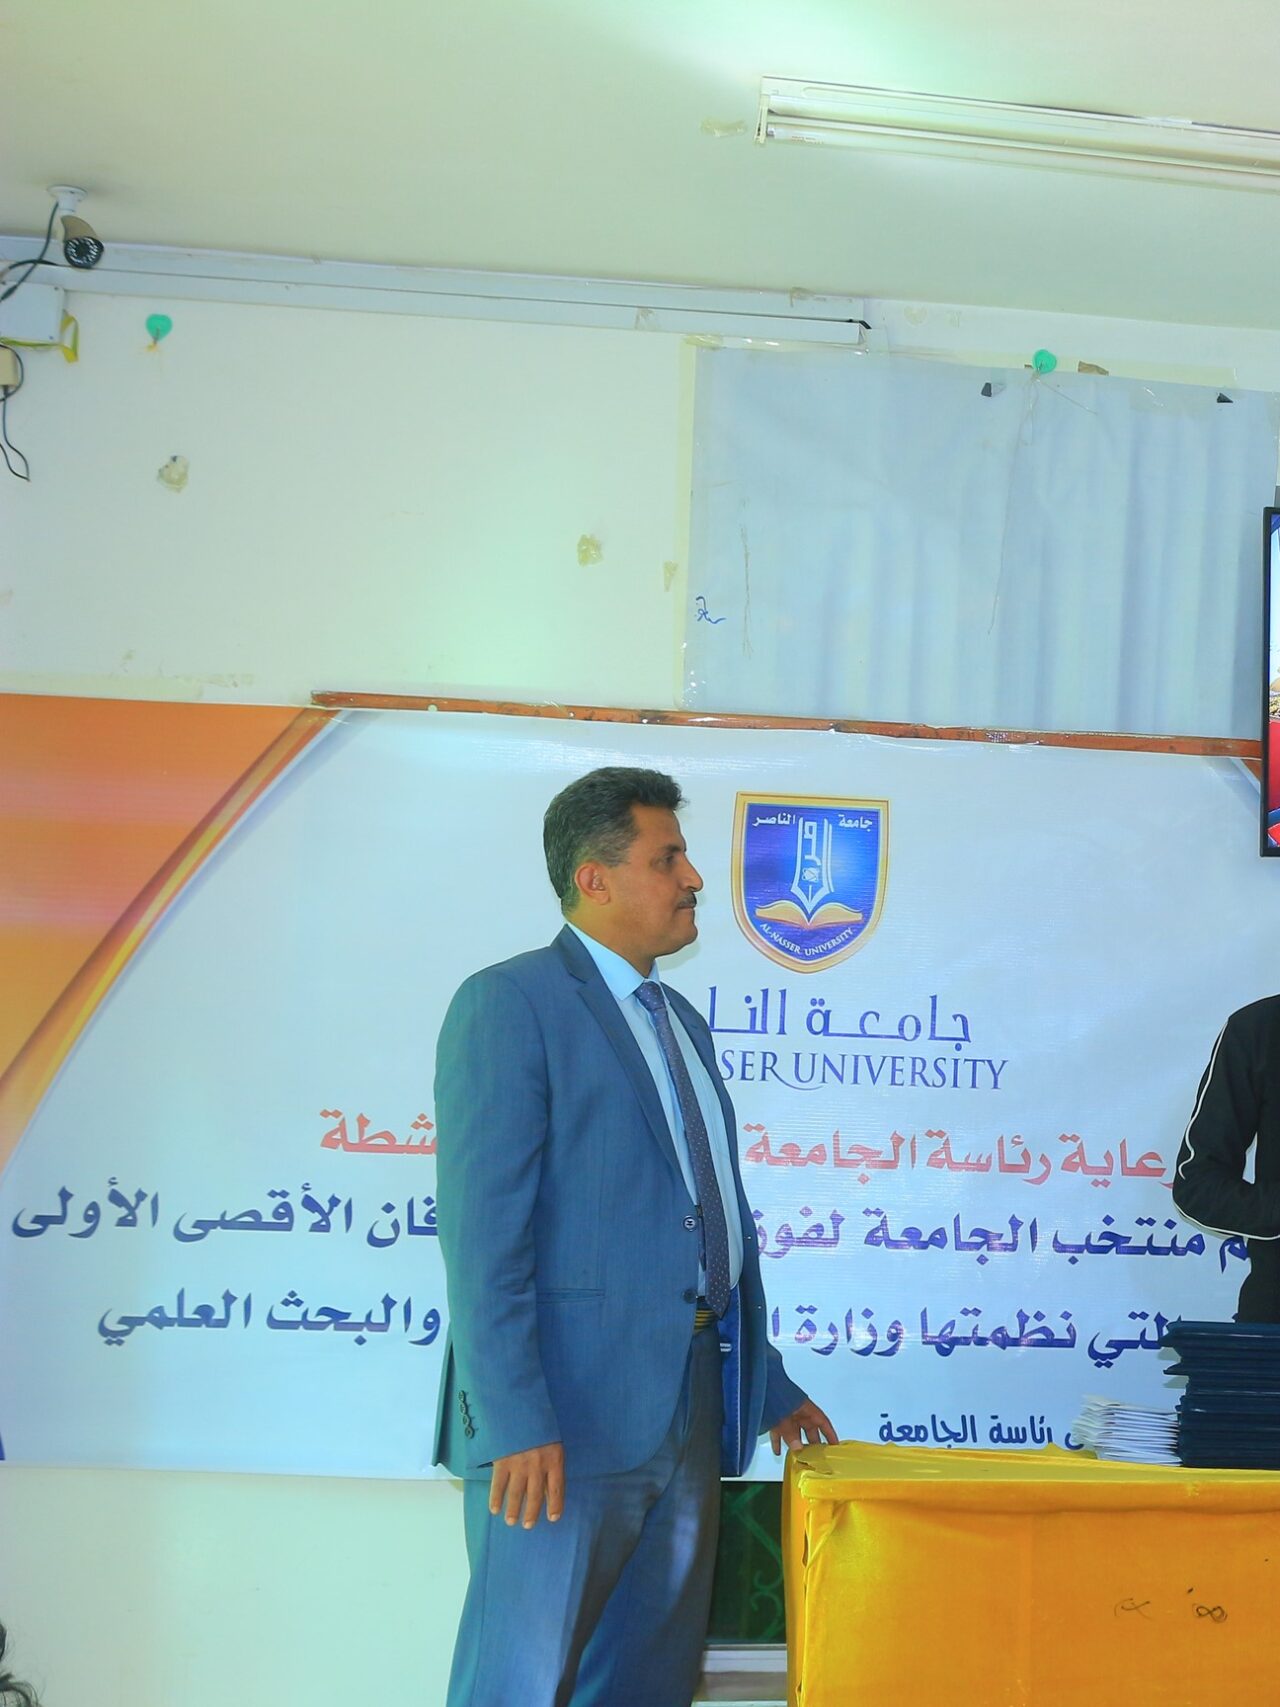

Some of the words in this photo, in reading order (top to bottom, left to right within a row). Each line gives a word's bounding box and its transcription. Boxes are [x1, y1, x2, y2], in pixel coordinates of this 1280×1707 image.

[752, 812, 796, 827] الناصر
[838, 813, 873, 832] جامعة
[760, 922, 801, 955] AL-NASSER
[804, 927, 855, 956] UNIVERSITY
[706, 985, 787, 1035] النا
[806, 994, 972, 1051] جامعة
[720, 1049, 823, 1091] SER
[792, 1052, 1009, 1090] UNIVERSITY
[319, 1109, 437, 1155] شطة
[743, 1123, 916, 1184] الجامعة
[925, 1129, 1052, 1186] رئاسة
[12, 1177, 159, 1238] الأولى
[173, 1182, 353, 1242] الأقصى
[367, 1196, 438, 1248] فان
[862, 1207, 1038, 1265] الجامعة
[1052, 1214, 1206, 1265] منتخب
[98, 1287, 252, 1346] العلمي
[266, 1289, 441, 1346] والبحث
[794, 1305, 904, 1356] وزارة
[920, 1306, 1077, 1357] نظمتها
[1087, 1311, 1182, 1369] لتي
[879, 1414, 978, 1449] الجامعة
